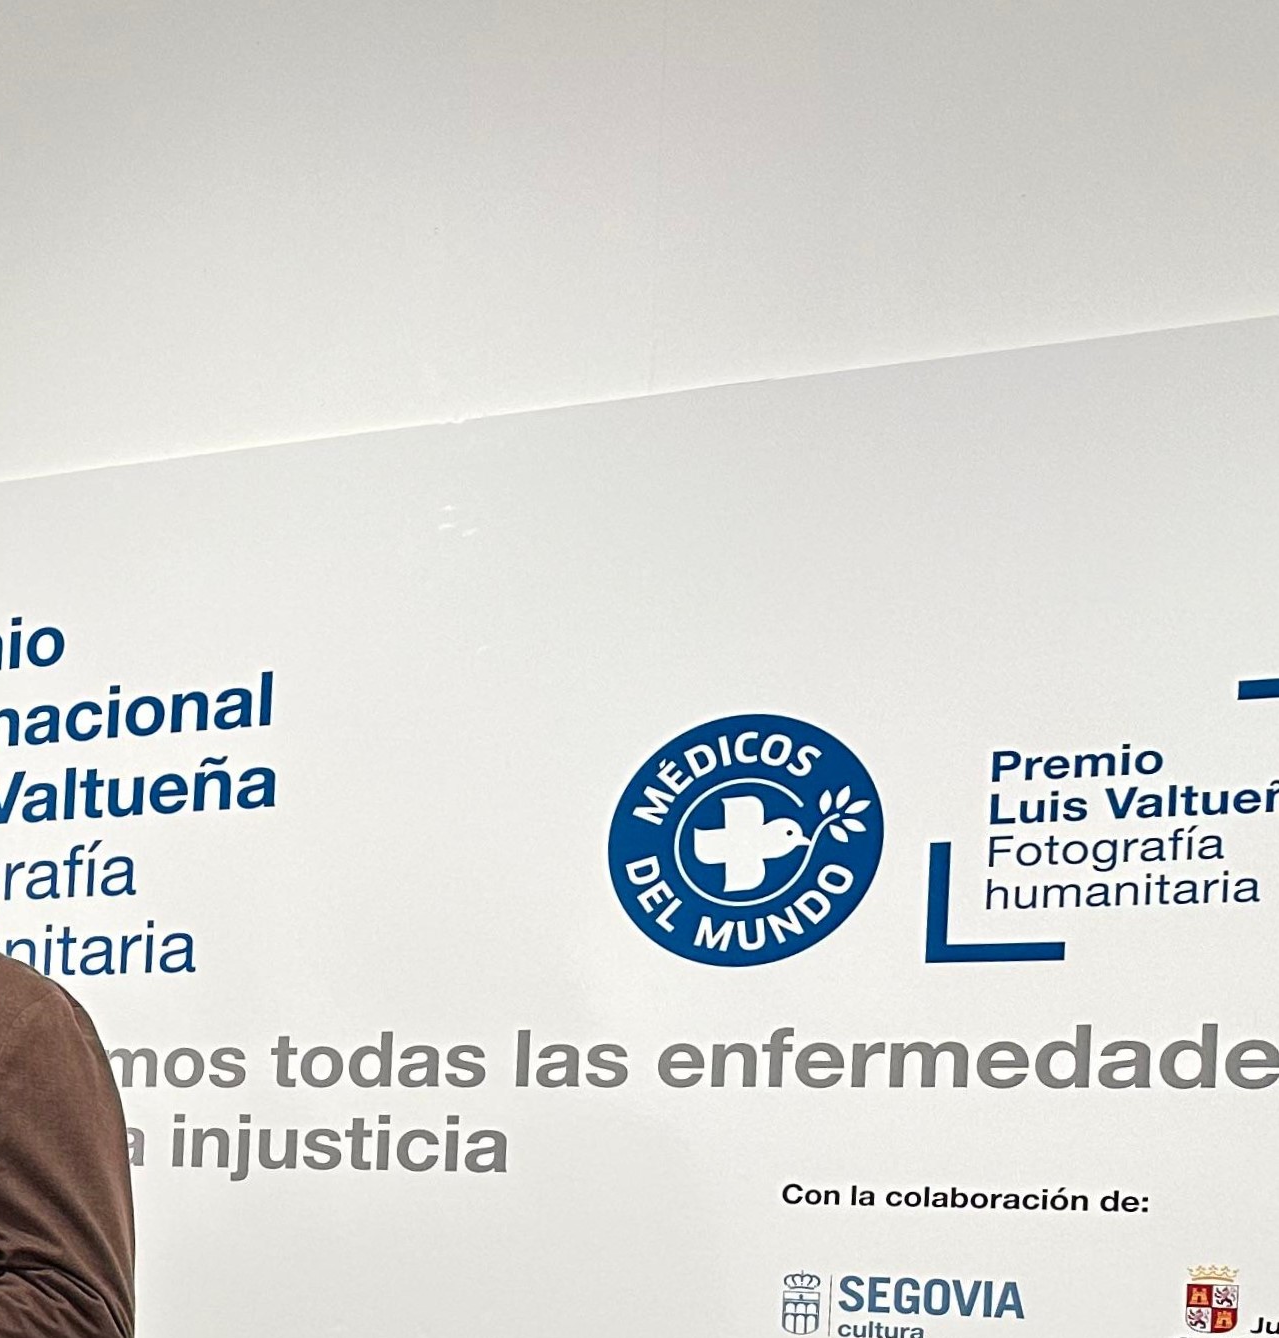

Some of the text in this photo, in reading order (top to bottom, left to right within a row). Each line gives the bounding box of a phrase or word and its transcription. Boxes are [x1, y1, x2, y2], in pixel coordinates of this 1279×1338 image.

[632, 731, 823, 826] MÉDICOS
[991, 743, 1164, 783] Premio
[989, 790, 1088, 825] Luis
[988, 825, 1225, 873] Fotografía
[625, 855, 855, 952] DEL MUNDO
[985, 870, 1261, 911] humanitaria
[271, 1030, 486, 1088] todas
[515, 1029, 629, 1088] las
[171, 1113, 508, 1182] injusticia
[781, 1182, 1150, 1214] Con la colaboración de:
[837, 1275, 1026, 1320] SEGOVIA
